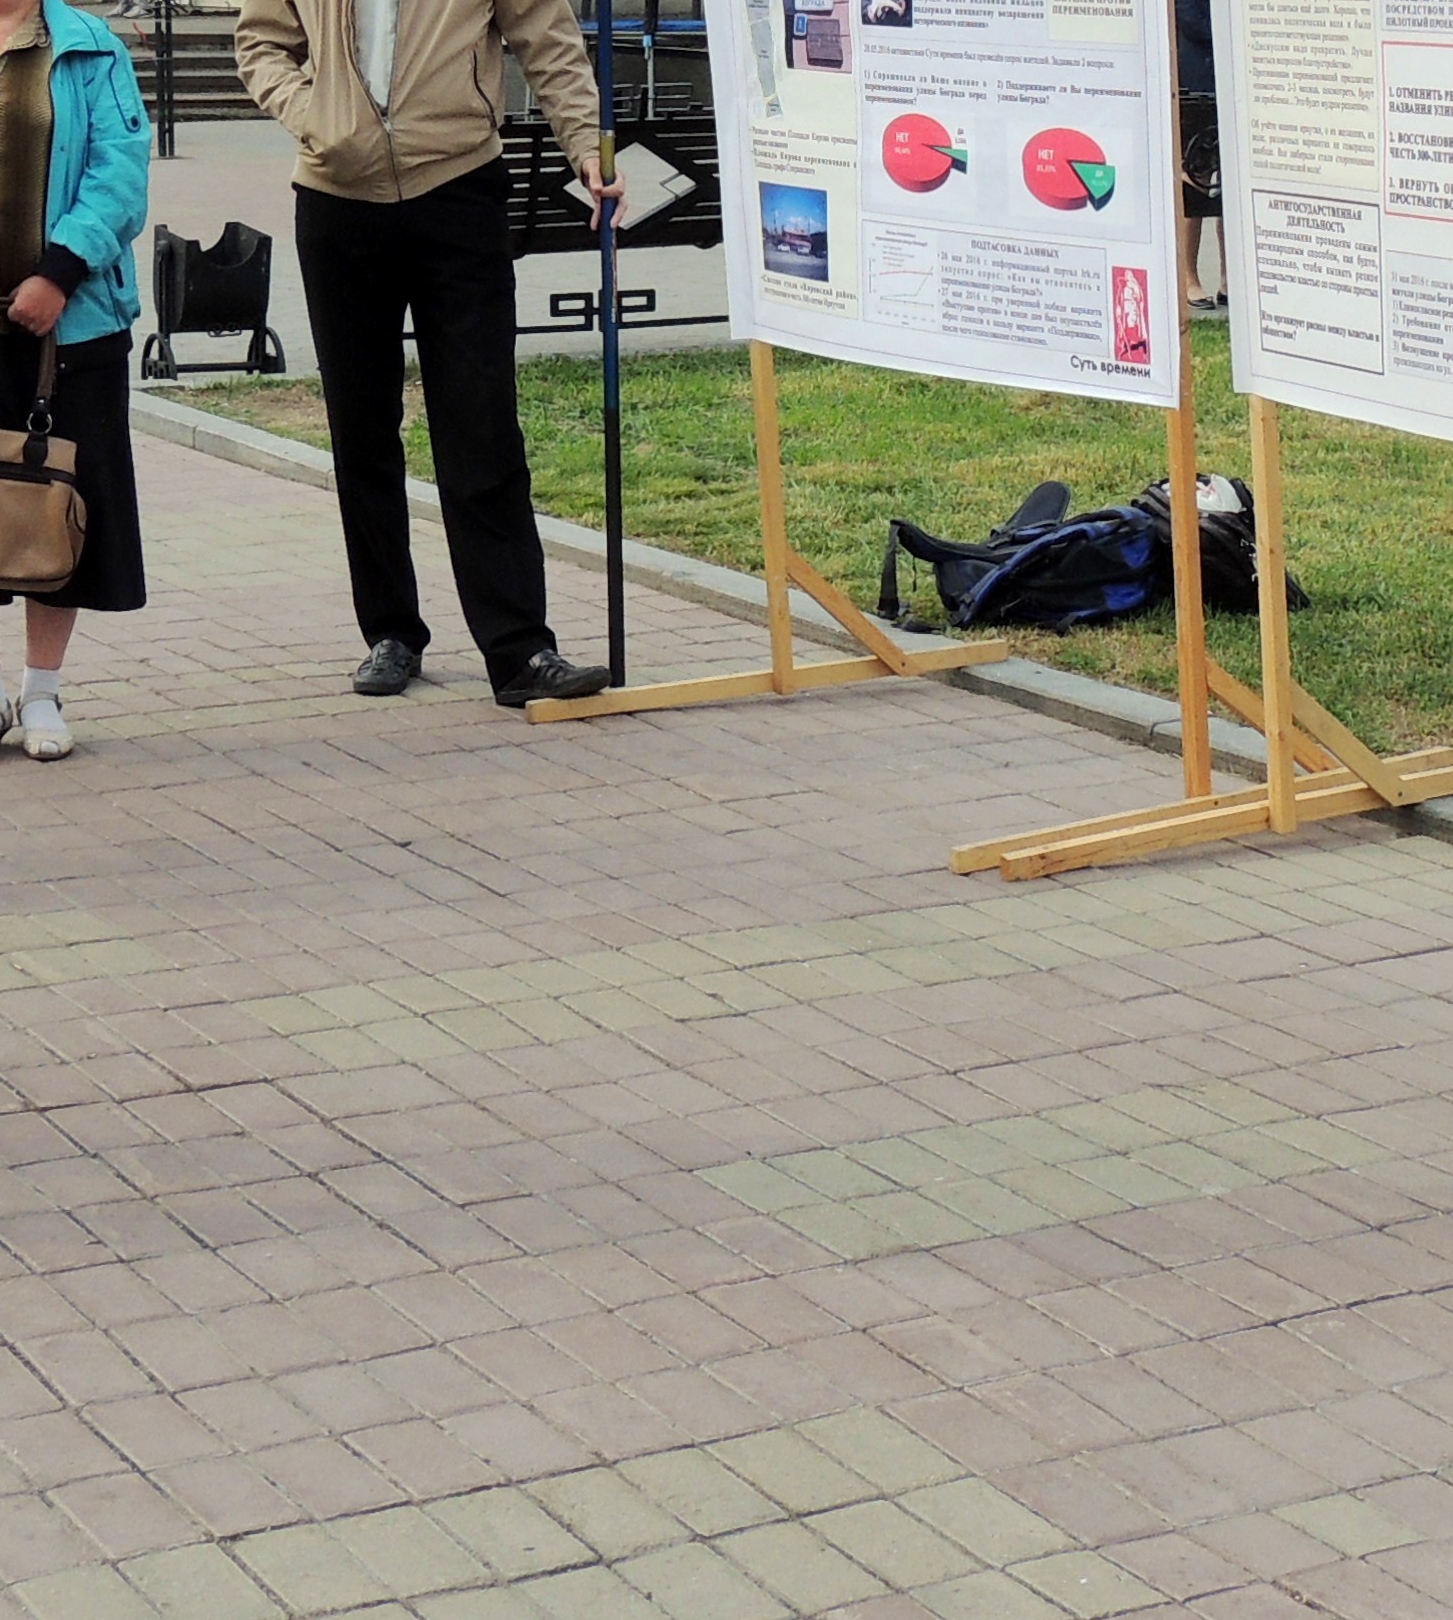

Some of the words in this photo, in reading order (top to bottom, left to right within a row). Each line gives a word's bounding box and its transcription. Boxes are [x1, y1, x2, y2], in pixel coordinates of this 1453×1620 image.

[895, 132, 910, 143] НЕТ
[1038, 149, 1054, 160] НЕТ
[1070, 356, 1097, 371] Суть
[1100, 363, 1151, 379] времени
